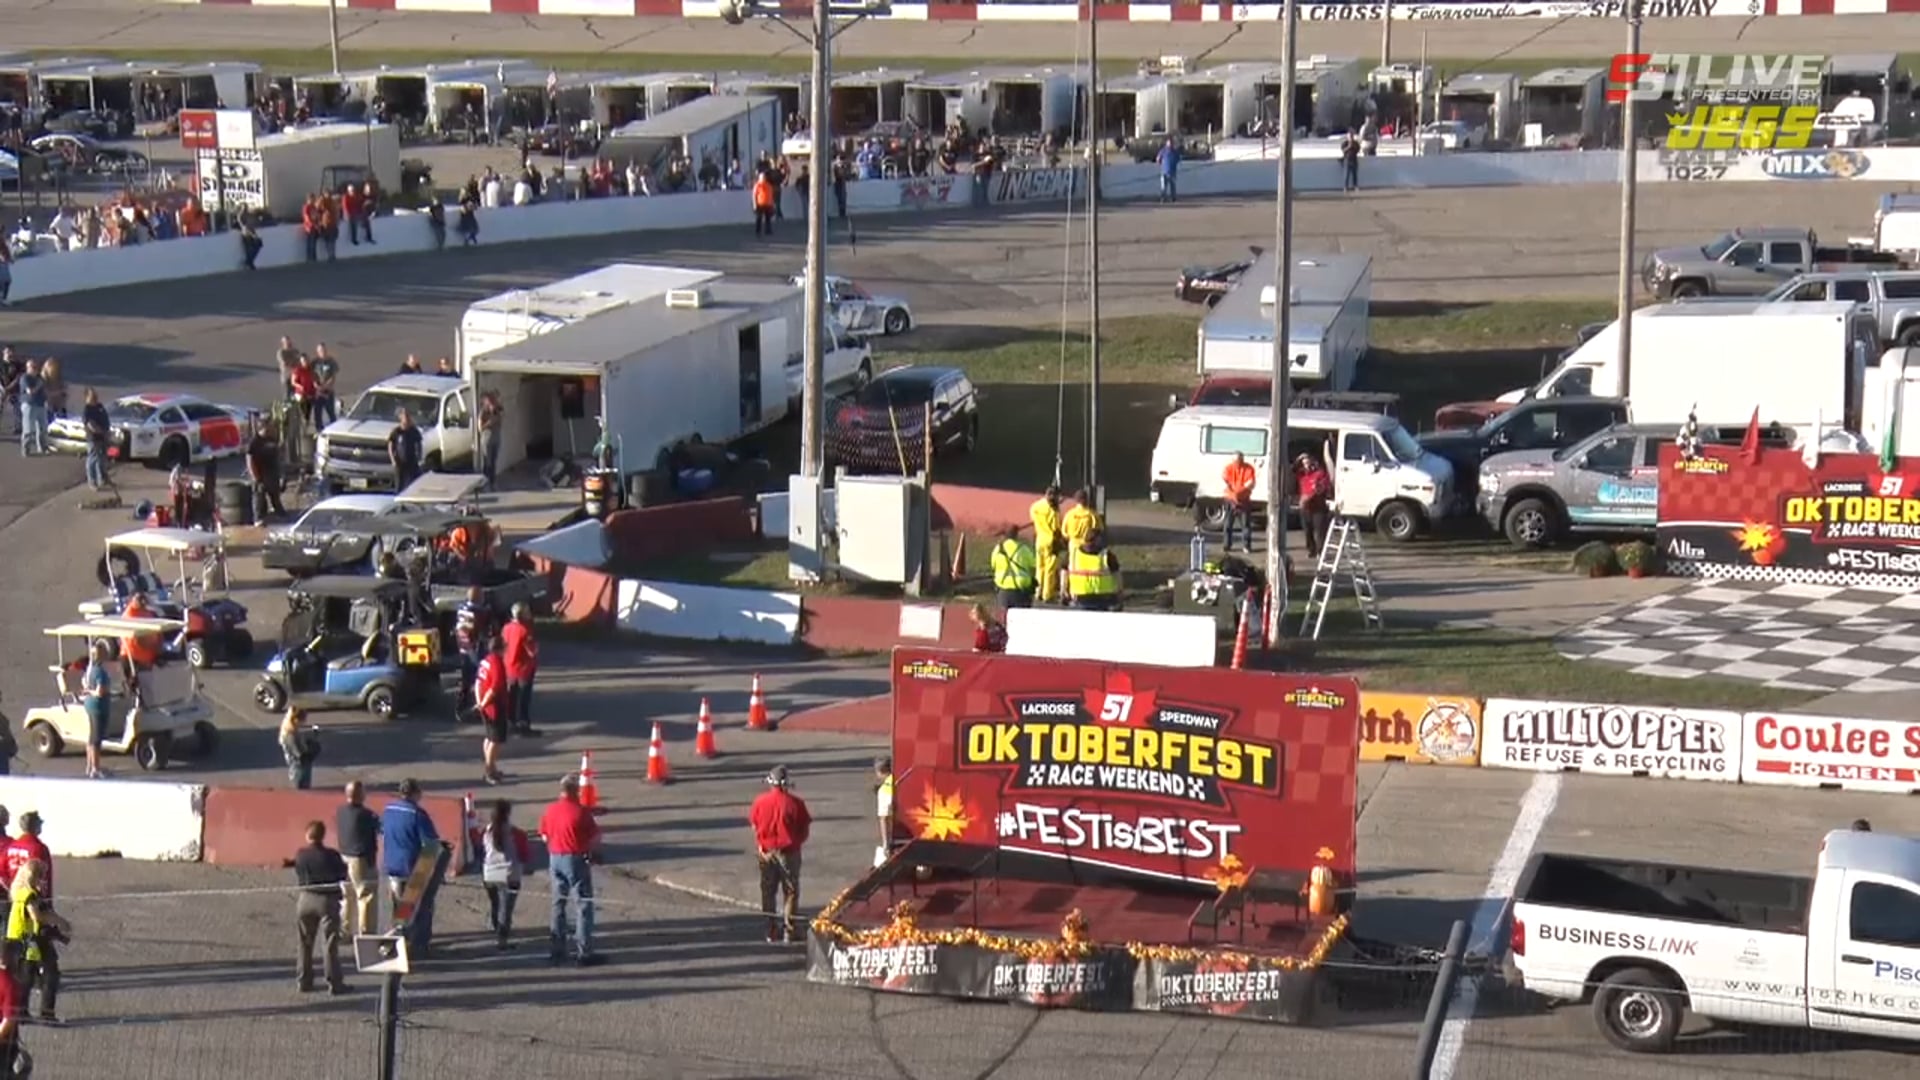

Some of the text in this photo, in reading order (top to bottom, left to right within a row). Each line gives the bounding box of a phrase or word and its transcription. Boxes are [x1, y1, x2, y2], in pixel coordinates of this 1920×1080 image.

[1666, 166, 1729, 181] 102.7
[1766, 155, 1829, 174] MIX
[1842, 522, 1876, 536] RACE
[1022, 703, 1076, 716] LACROSSE
[1159, 711, 1219, 729] SPEEDWAY
[1755, 716, 1890, 757] Coulee
[968, 723, 1272, 785] OKTOBERFEST
[1506, 747, 1726, 772] REFUSE & RECYCLING
[1048, 765, 1185, 796] RACE WEEKEND
[1790, 762, 1896, 781] HOLMEN
[833, 945, 938, 970] OKTOBERFEST
[994, 962, 1105, 985] OKTOBERFEST
[1161, 970, 1280, 996] OKTOBERFEST
